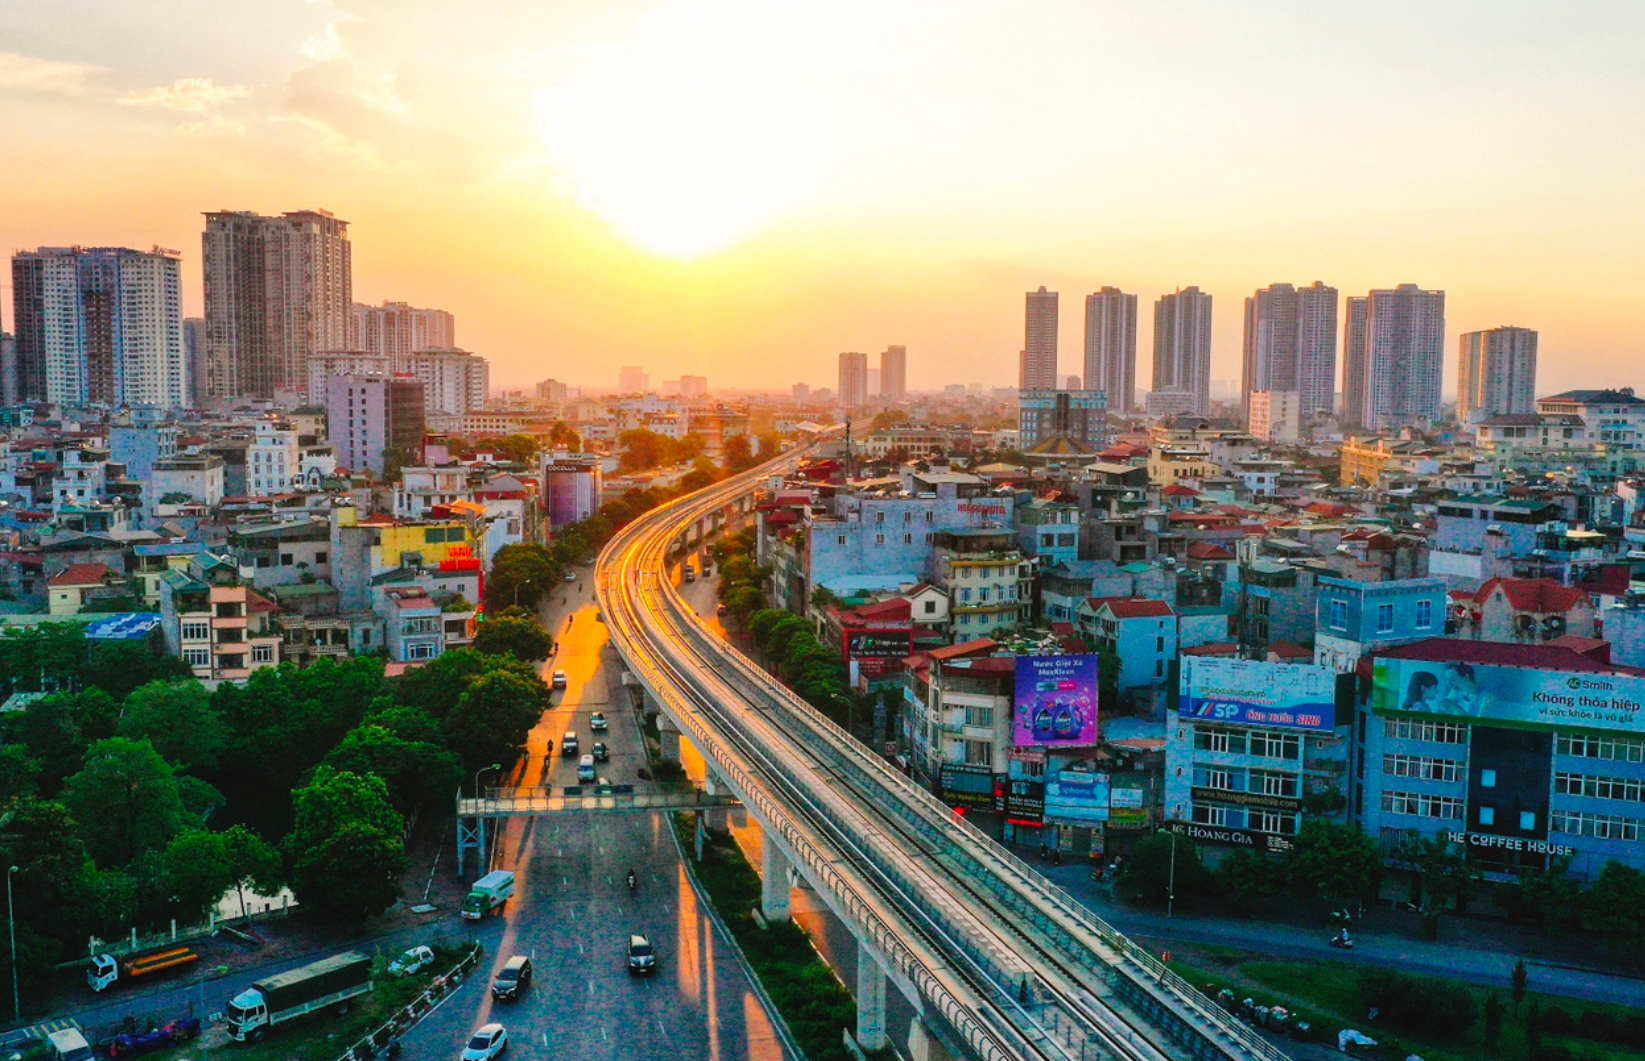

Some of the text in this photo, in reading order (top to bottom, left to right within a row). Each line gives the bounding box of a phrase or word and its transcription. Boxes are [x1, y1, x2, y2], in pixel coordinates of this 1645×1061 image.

[1214, 703, 1239, 718] SP
[1532, 691, 1641, 712] Không thỏa hiệp
[1550, 708, 1566, 717] sức
[1594, 710, 1603, 720] là
[1470, 834, 1523, 851] COFFEE
[1527, 841, 1574, 856] HOUSE
